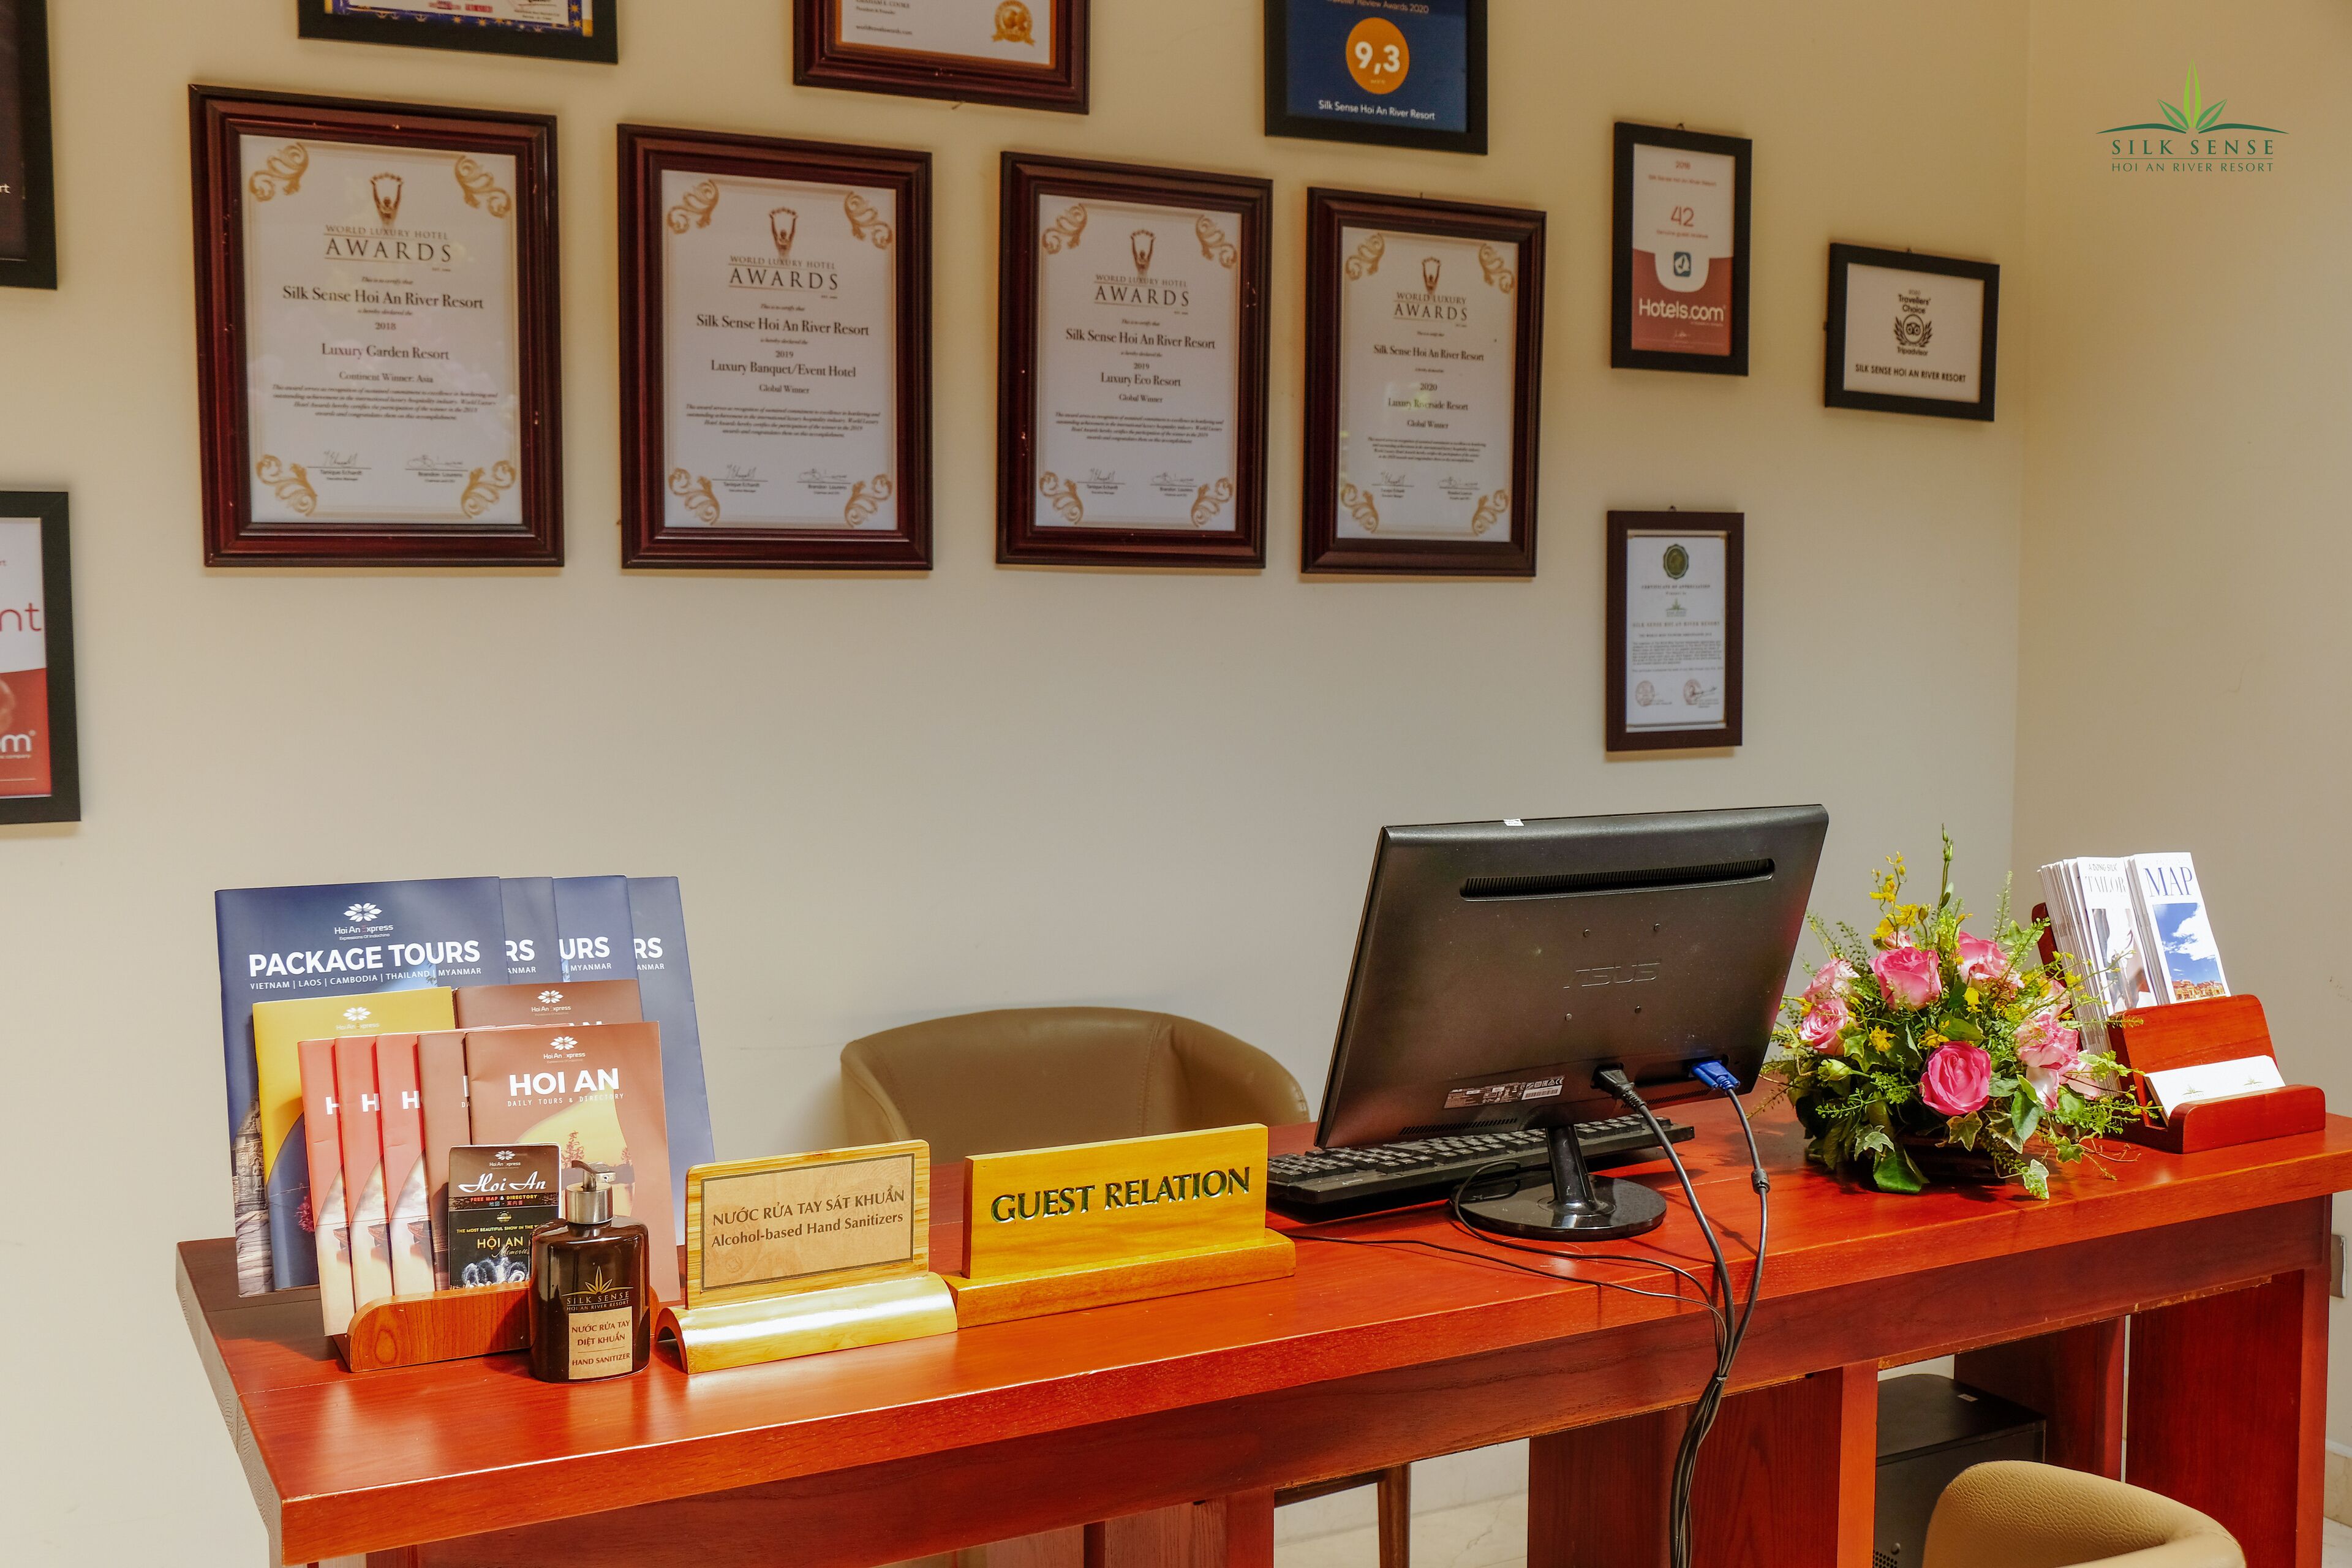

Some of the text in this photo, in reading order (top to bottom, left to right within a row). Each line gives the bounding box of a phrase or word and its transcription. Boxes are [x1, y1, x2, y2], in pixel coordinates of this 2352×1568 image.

[1355, 41, 1401, 75] 9,3
[1318, 100, 1436, 121] Silk Sense Hoi An River Resort
[1670, 205, 1695, 228] 42
[325, 224, 448, 240] WORLD LUXURY HOTEL
[325, 238, 452, 263] AWARDS
[729, 255, 836, 270] WORLD LUXURY HOTEL
[729, 268, 839, 291] AWARDS
[1095, 274, 1187, 287] WORLD LUXURY HOTEL
[282, 285, 484, 309] Silk Sense Hoi An River Resort
[1095, 285, 1189, 307] AWARDS
[1396, 292, 1430, 302] WORLD
[1394, 303, 1468, 321] AWARDS
[1638, 298, 1724, 322] Hotels.com
[1902, 304, 1926, 314] Choice
[374, 322, 397, 331] 2018
[696, 314, 869, 336] Silk Sense Hoi An River Resort
[1066, 328, 1216, 350] Silk Sense Hoi An River Resort
[321, 342, 450, 361] Luxury Garden Resort
[775, 350, 794, 358] 2019
[1373, 344, 1485, 361] Silk Sense Hoi An River Resort
[1897, 346, 1929, 356] Tripadvisor
[339, 371, 380, 382] Continent
[417, 374, 434, 384] Asia
[710, 360, 857, 378] Luxury Banquet/Event Hotel
[1855, 363, 1966, 383] SILK SENSE HOI AN RIVER RESORT
[1101, 372, 1182, 387] Luxury Eco Resort
[1419, 383, 1438, 391] 2020
[759, 383, 810, 394] Global Winner
[1118, 394, 1163, 403] Global Winner
[1388, 398, 1412, 410] Luxury
[1446, 401, 1469, 411] Resort
[2085, 876, 2127, 893] TAILOR
[2144, 867, 2193, 897] MAP
[334, 926, 347, 935] Hoi
[349, 925, 361, 934] An
[559, 936, 611, 960] URS
[249, 944, 383, 978] PACKAGE
[388, 940, 481, 968] TOURS
[570, 962, 612, 973] MYANMAR
[637, 962, 665, 971] ANMAR
[250, 967, 482, 990] VIETNAM LAOS CAMBODIA THAILAND MYANMAR
[508, 966, 537, 975] ANMAR
[510, 1068, 620, 1097] HOI AN
[507, 1098, 533, 1107] DAILY
[579, 1093, 625, 1102] DIRECTORY
[458, 1170, 546, 1193] Hoi An
[990, 1166, 1251, 1224] GUEST RELATION
[712, 1184, 905, 1226] NƯỚC RỬA TAY SÁT KHUẨN
[711, 1212, 904, 1248] Alcohol-based Hand Sanitizers
[477, 1235, 524, 1250] HỘI AN
[597, 1291, 630, 1302] SENSE
[571, 1319, 630, 1333] NƯỚC RỬA TAY
[577, 1331, 625, 1347] DIỆT KHUẨN
[596, 1352, 630, 1363] SANITIZER
